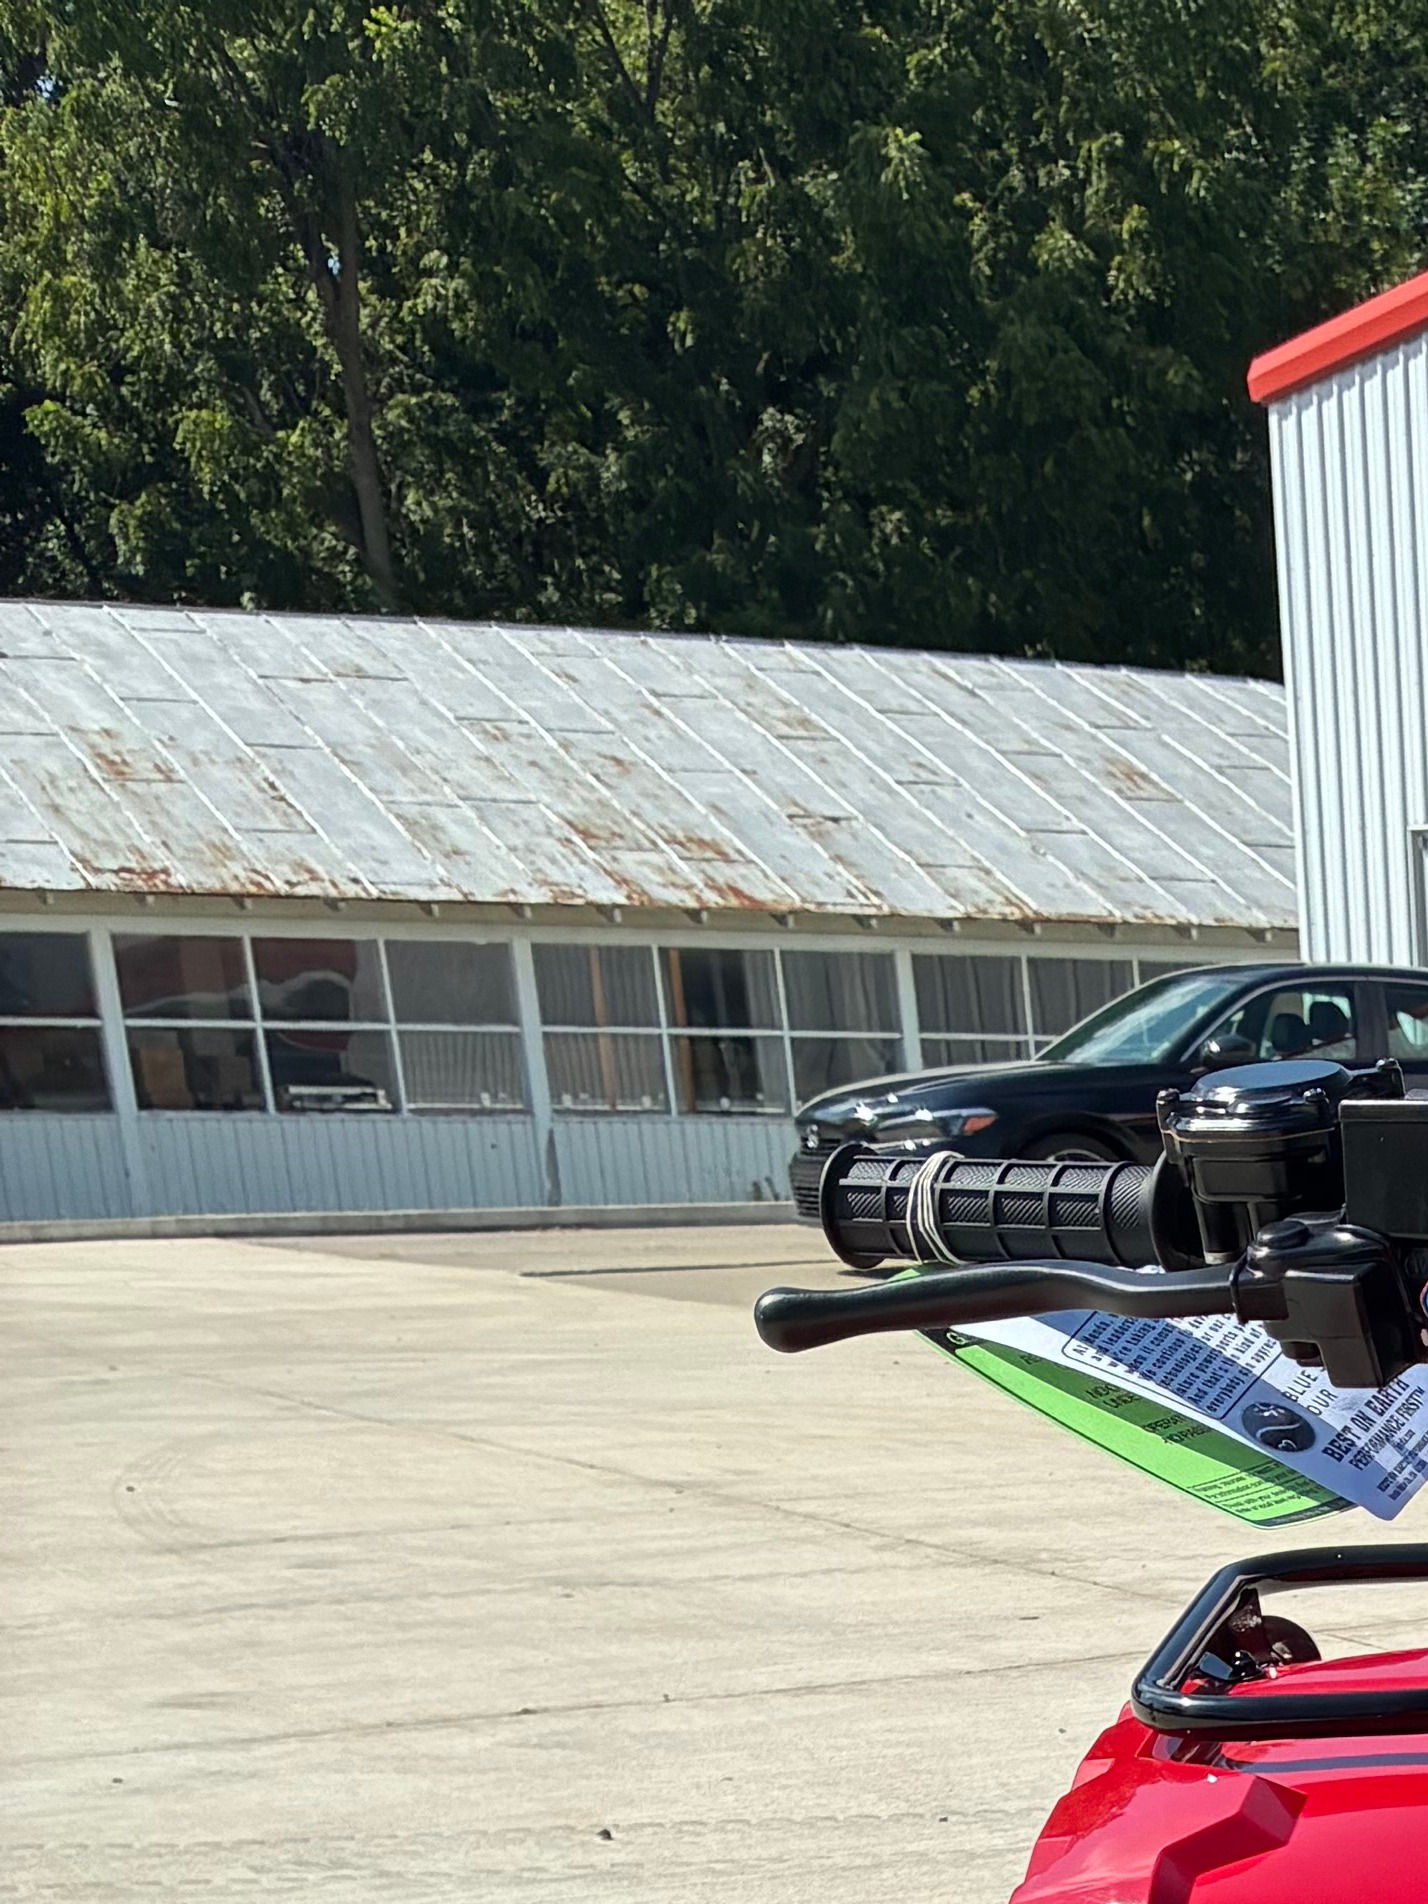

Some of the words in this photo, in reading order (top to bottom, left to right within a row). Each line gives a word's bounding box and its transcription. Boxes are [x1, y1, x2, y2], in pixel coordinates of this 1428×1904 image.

[1283, 1369, 1318, 1402] BLUE
[1306, 1388, 1339, 1415] OUR
[1322, 1424, 1360, 1463] BEST
[1351, 1408, 1377, 1435] ON
[1364, 1374, 1410, 1415] EARTH
[1348, 1410, 1406, 1471] PERFORMANCE
